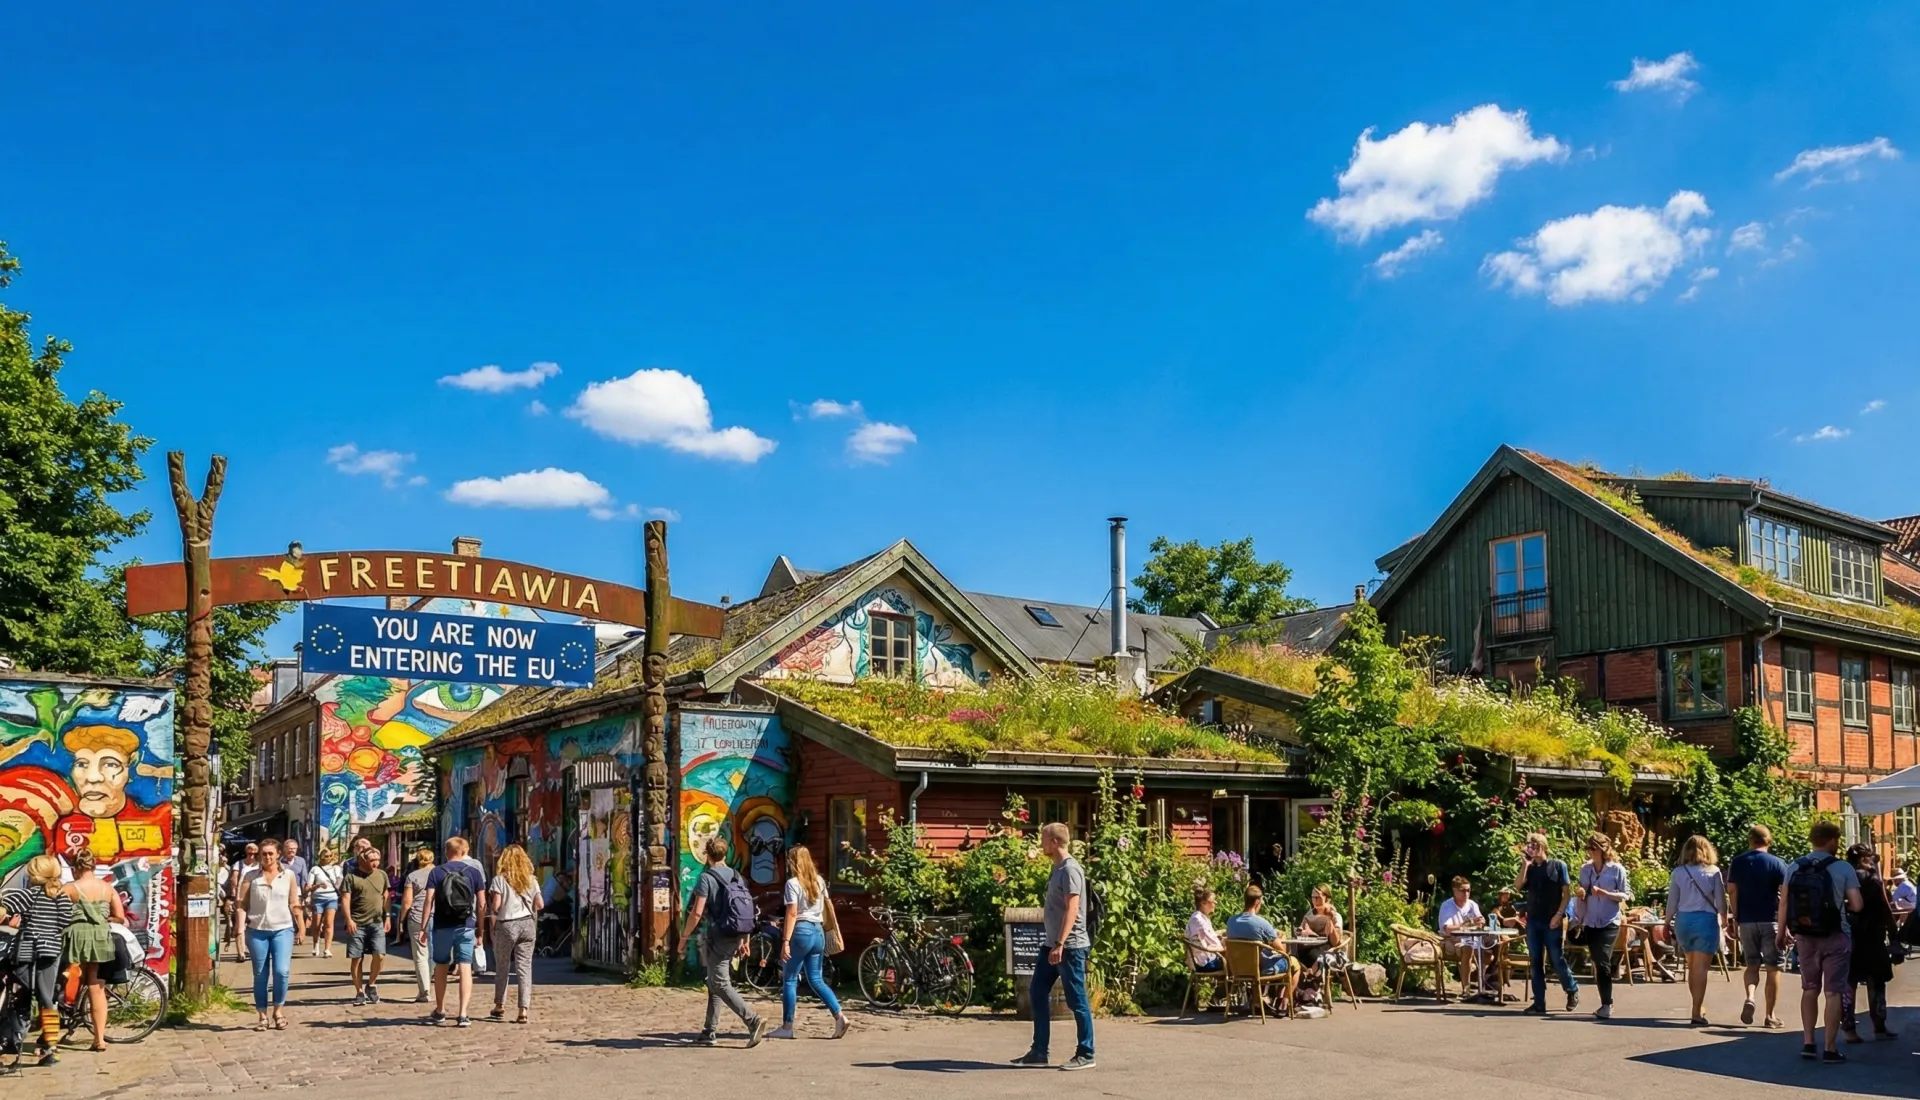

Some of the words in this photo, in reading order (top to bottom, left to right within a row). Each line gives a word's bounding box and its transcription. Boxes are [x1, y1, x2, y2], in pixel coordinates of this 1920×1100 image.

[319, 556, 600, 614] FREETIAWIA
[372, 616, 418, 642] YOU
[430, 621, 474, 646] ARE
[487, 626, 537, 650] NOW
[350, 645, 463, 674] ENTERING
[475, 653, 518, 678] THE
[527, 657, 555, 680] EU
